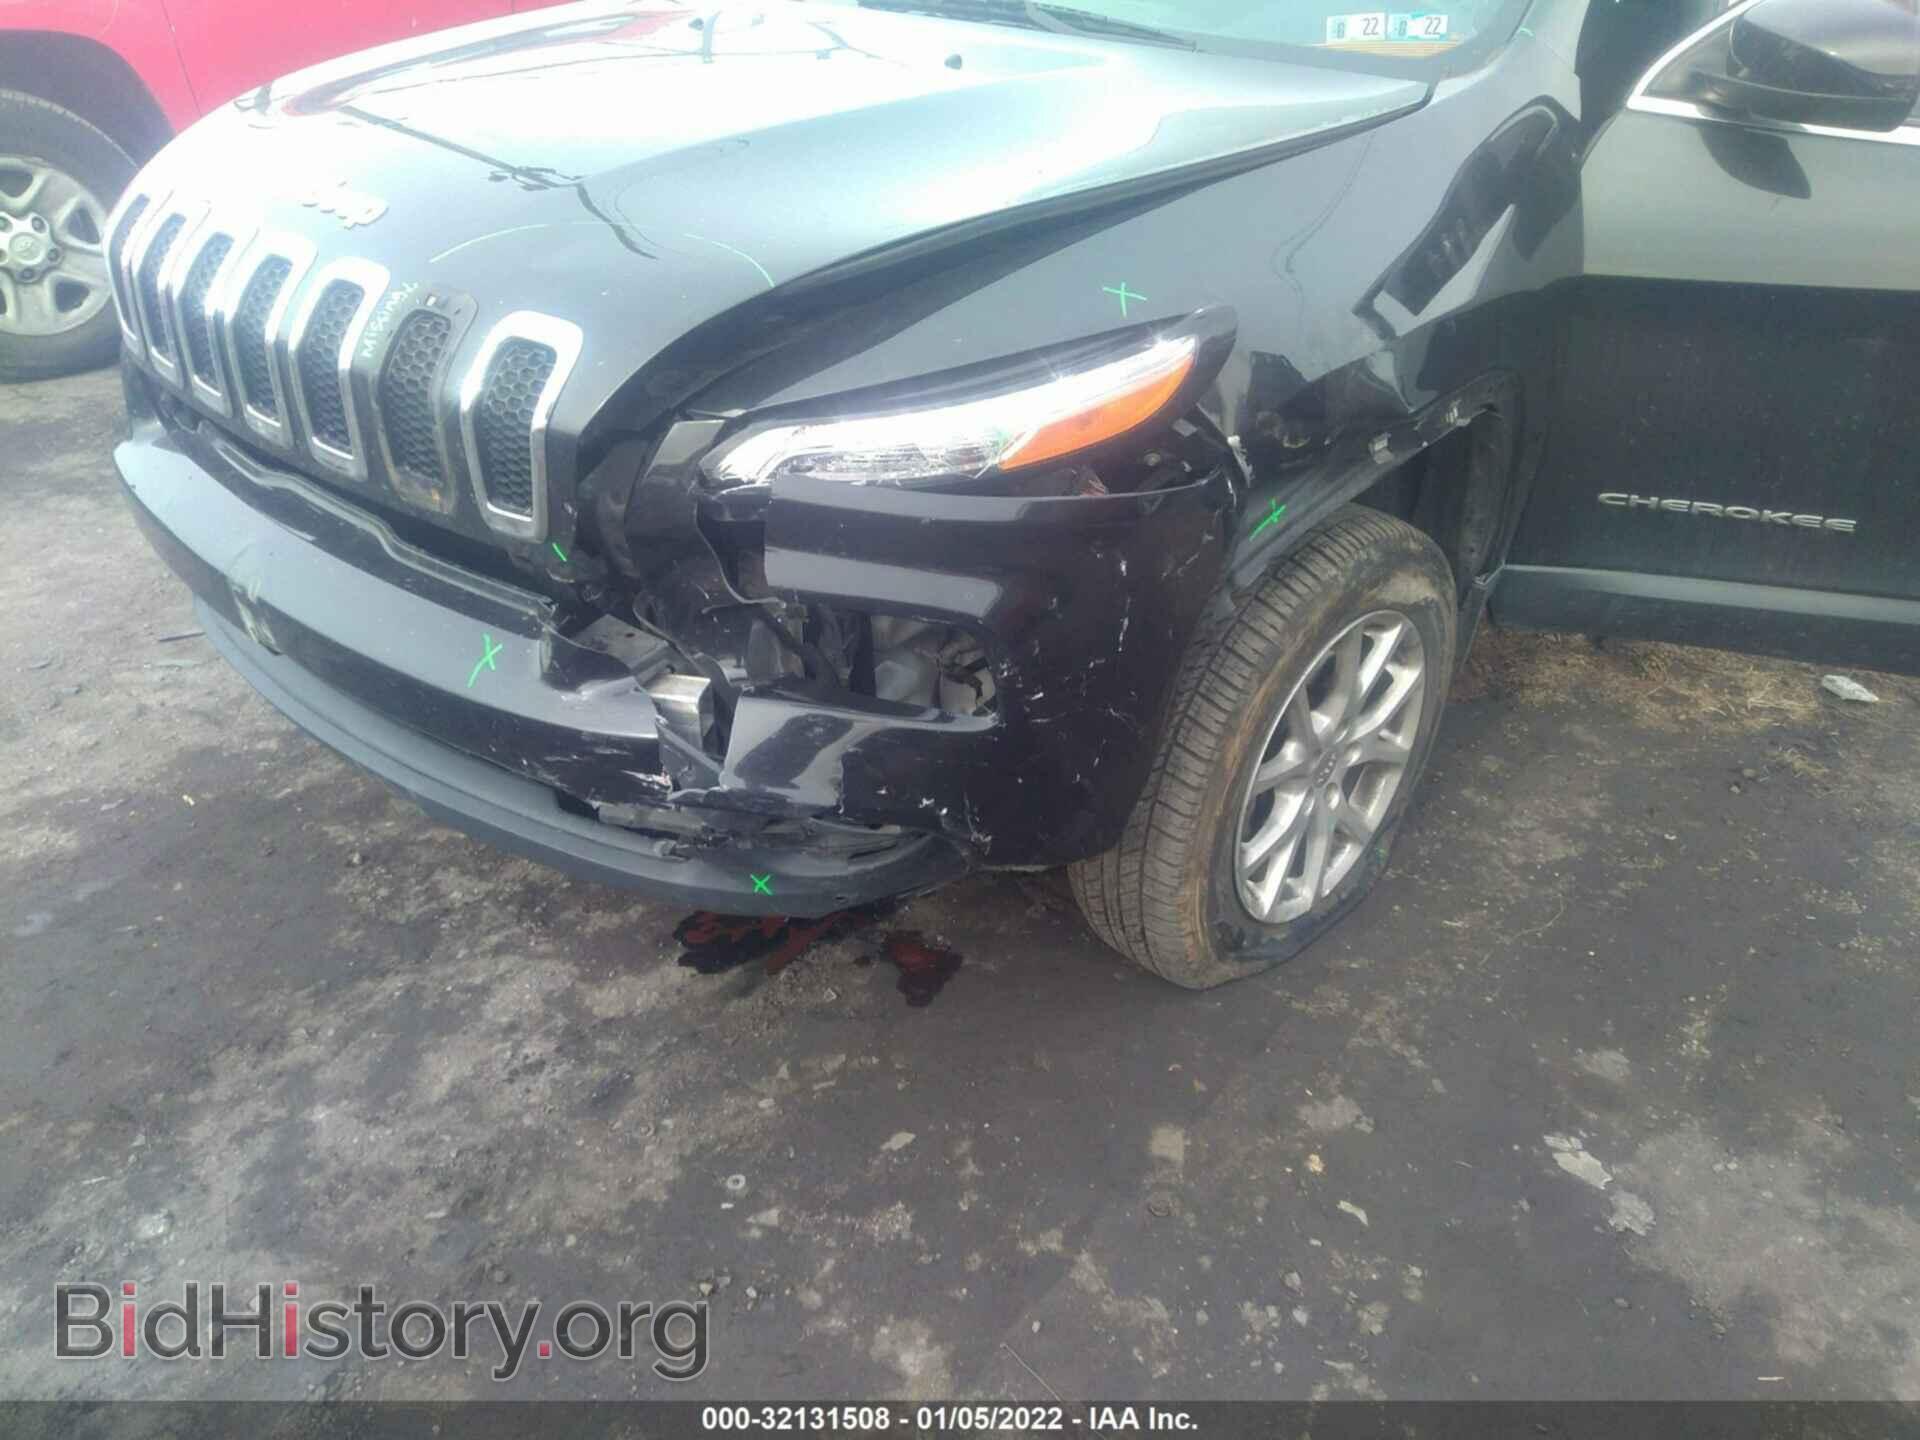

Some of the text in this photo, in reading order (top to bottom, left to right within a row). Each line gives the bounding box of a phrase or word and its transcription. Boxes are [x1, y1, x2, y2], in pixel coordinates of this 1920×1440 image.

[1362, 17, 1379, 36] 22
[1424, 16, 1442, 36] 22
[1598, 492, 1857, 532] CHEROKEE
